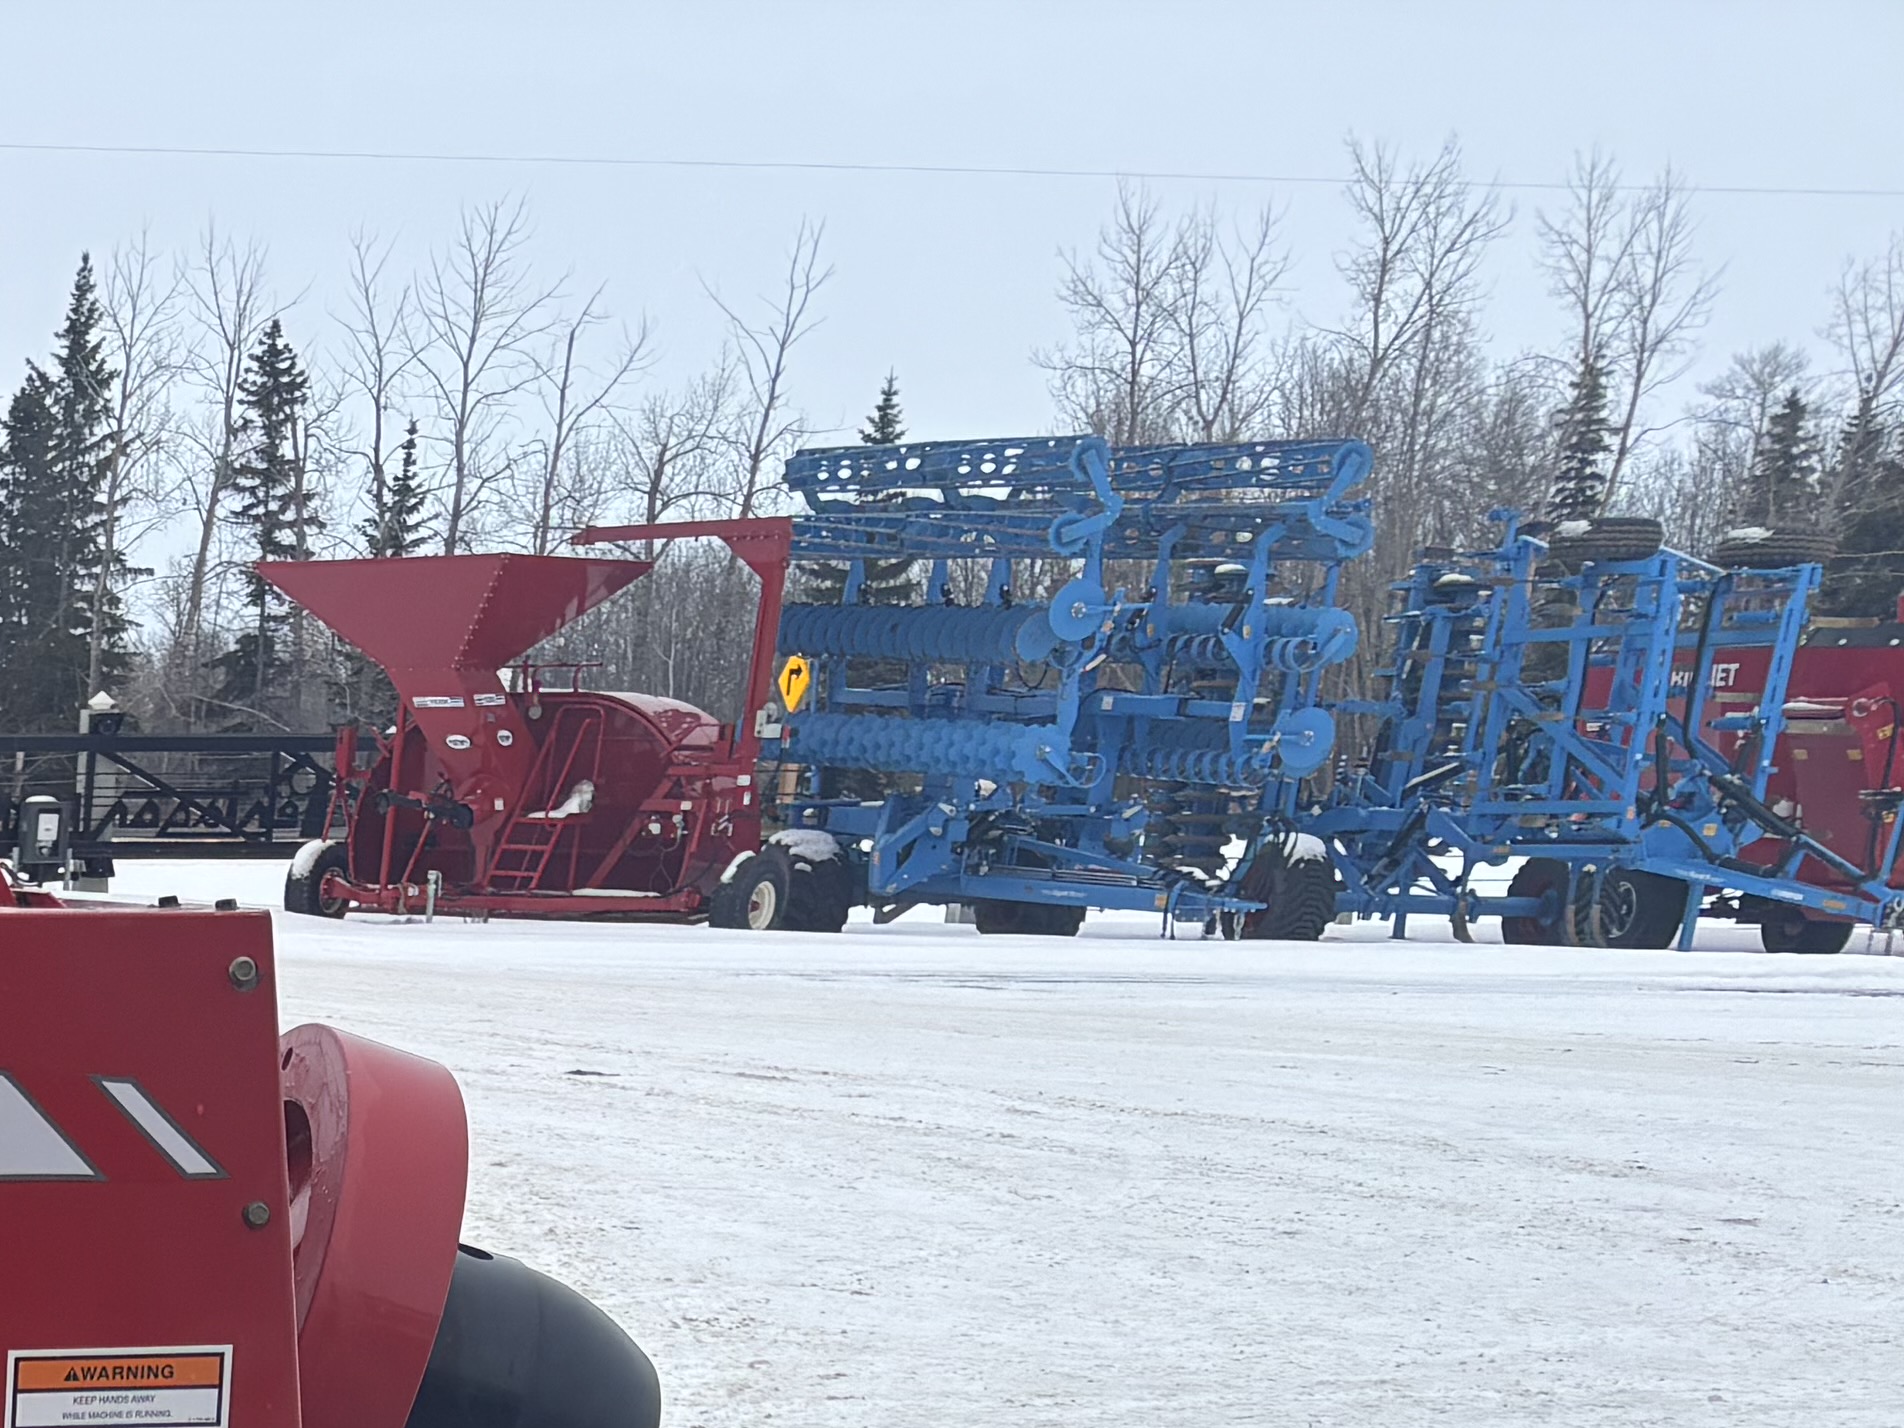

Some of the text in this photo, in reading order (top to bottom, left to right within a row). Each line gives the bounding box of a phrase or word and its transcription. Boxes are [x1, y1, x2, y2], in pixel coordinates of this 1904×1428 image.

[81, 1364, 175, 1381] WARNING
[73, 1395, 156, 1405] KEEP HANDS AWAY
